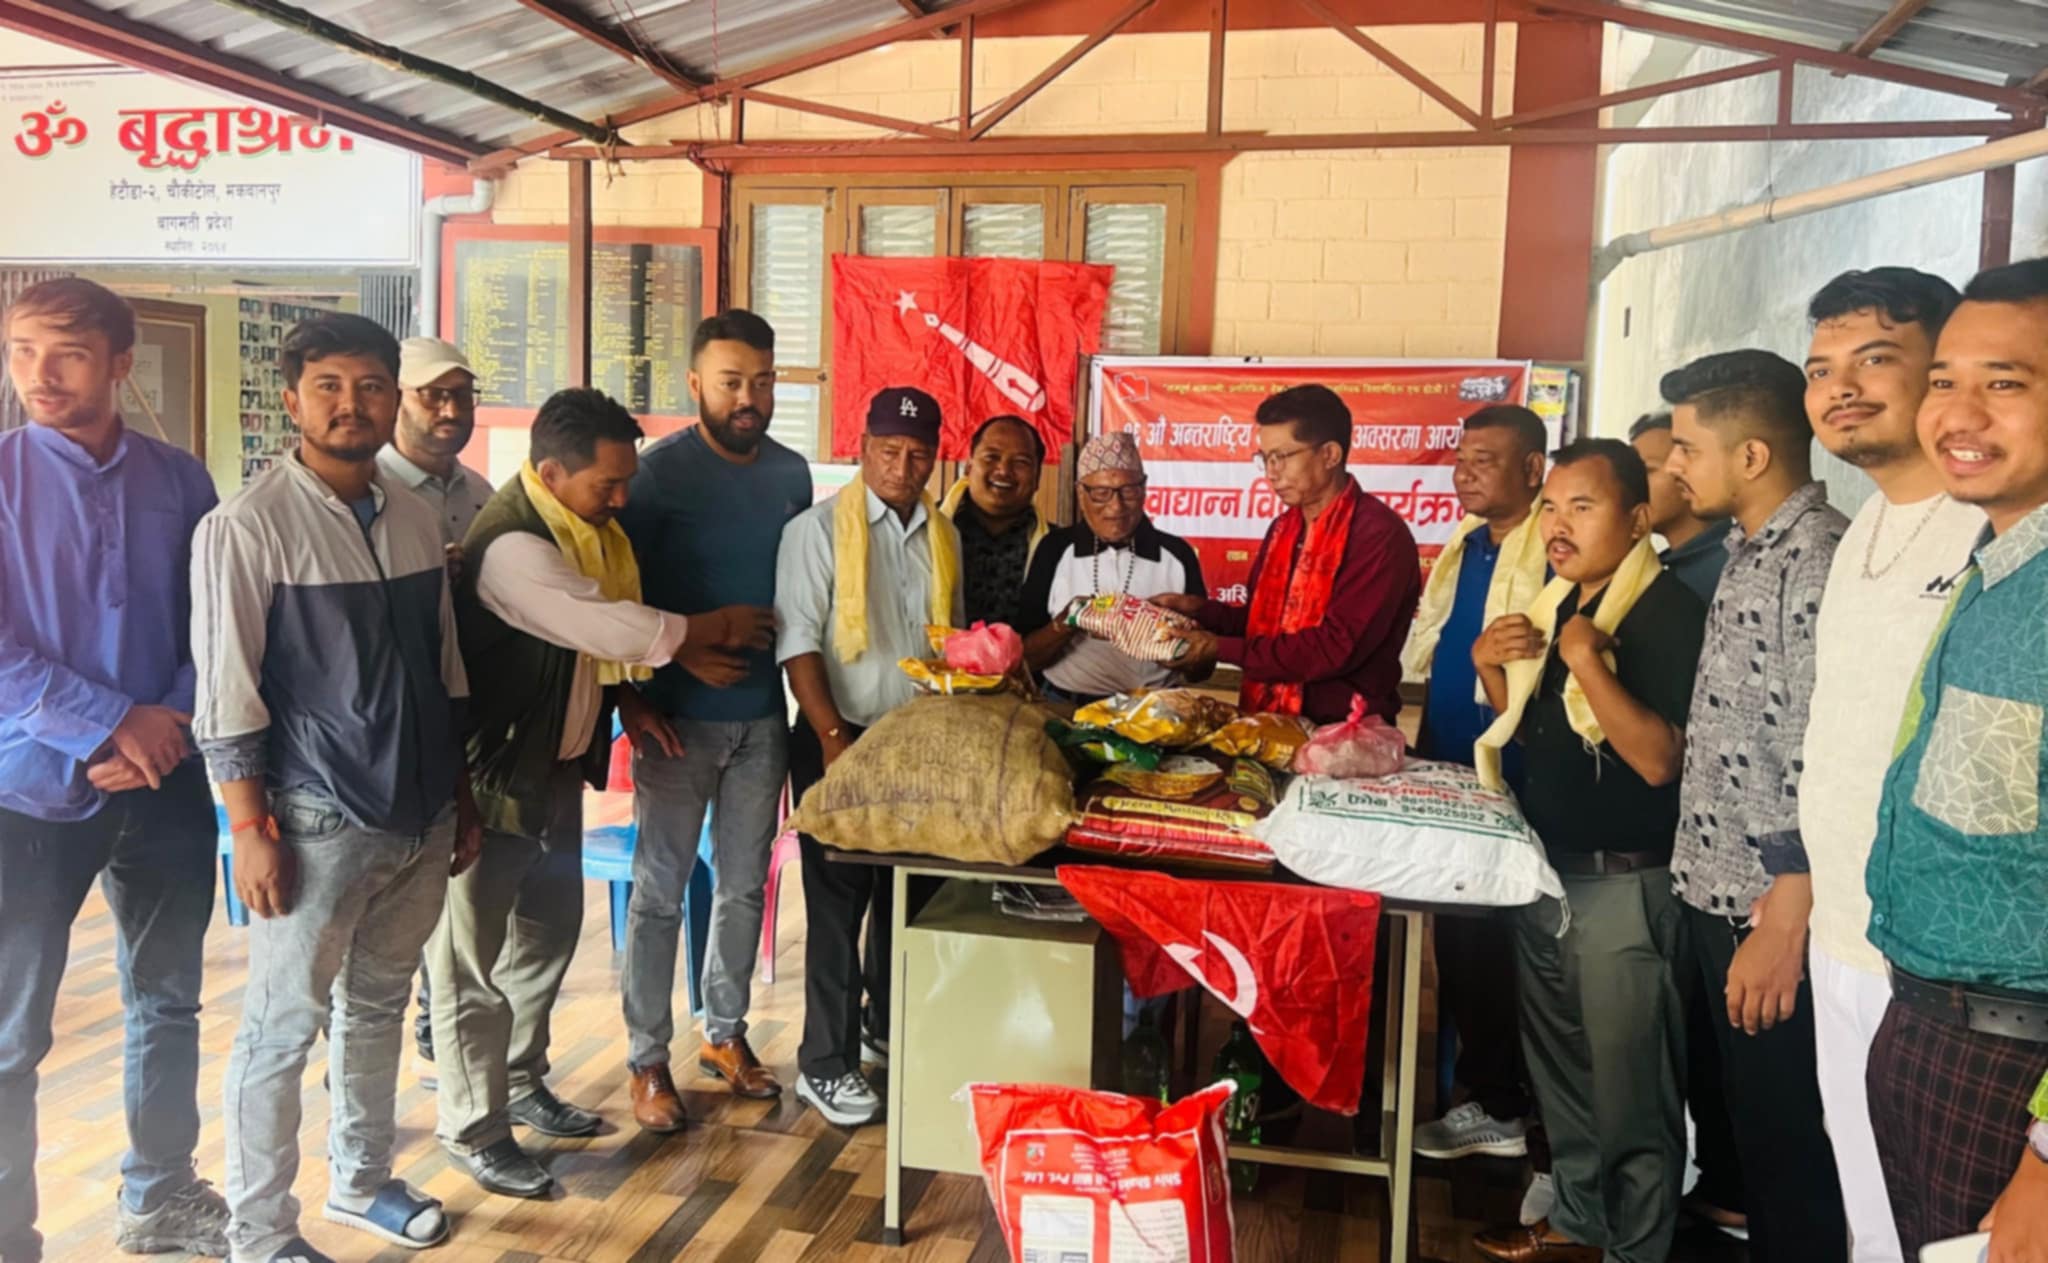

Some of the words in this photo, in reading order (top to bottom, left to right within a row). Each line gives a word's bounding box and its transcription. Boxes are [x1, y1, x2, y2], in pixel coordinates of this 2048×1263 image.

[900, 396, 918, 418] LA
[1352, 424, 1422, 451] अवसरमा
[1425, 417, 1465, 450] आयो
[1154, 1172, 1182, 1187] Shiv
